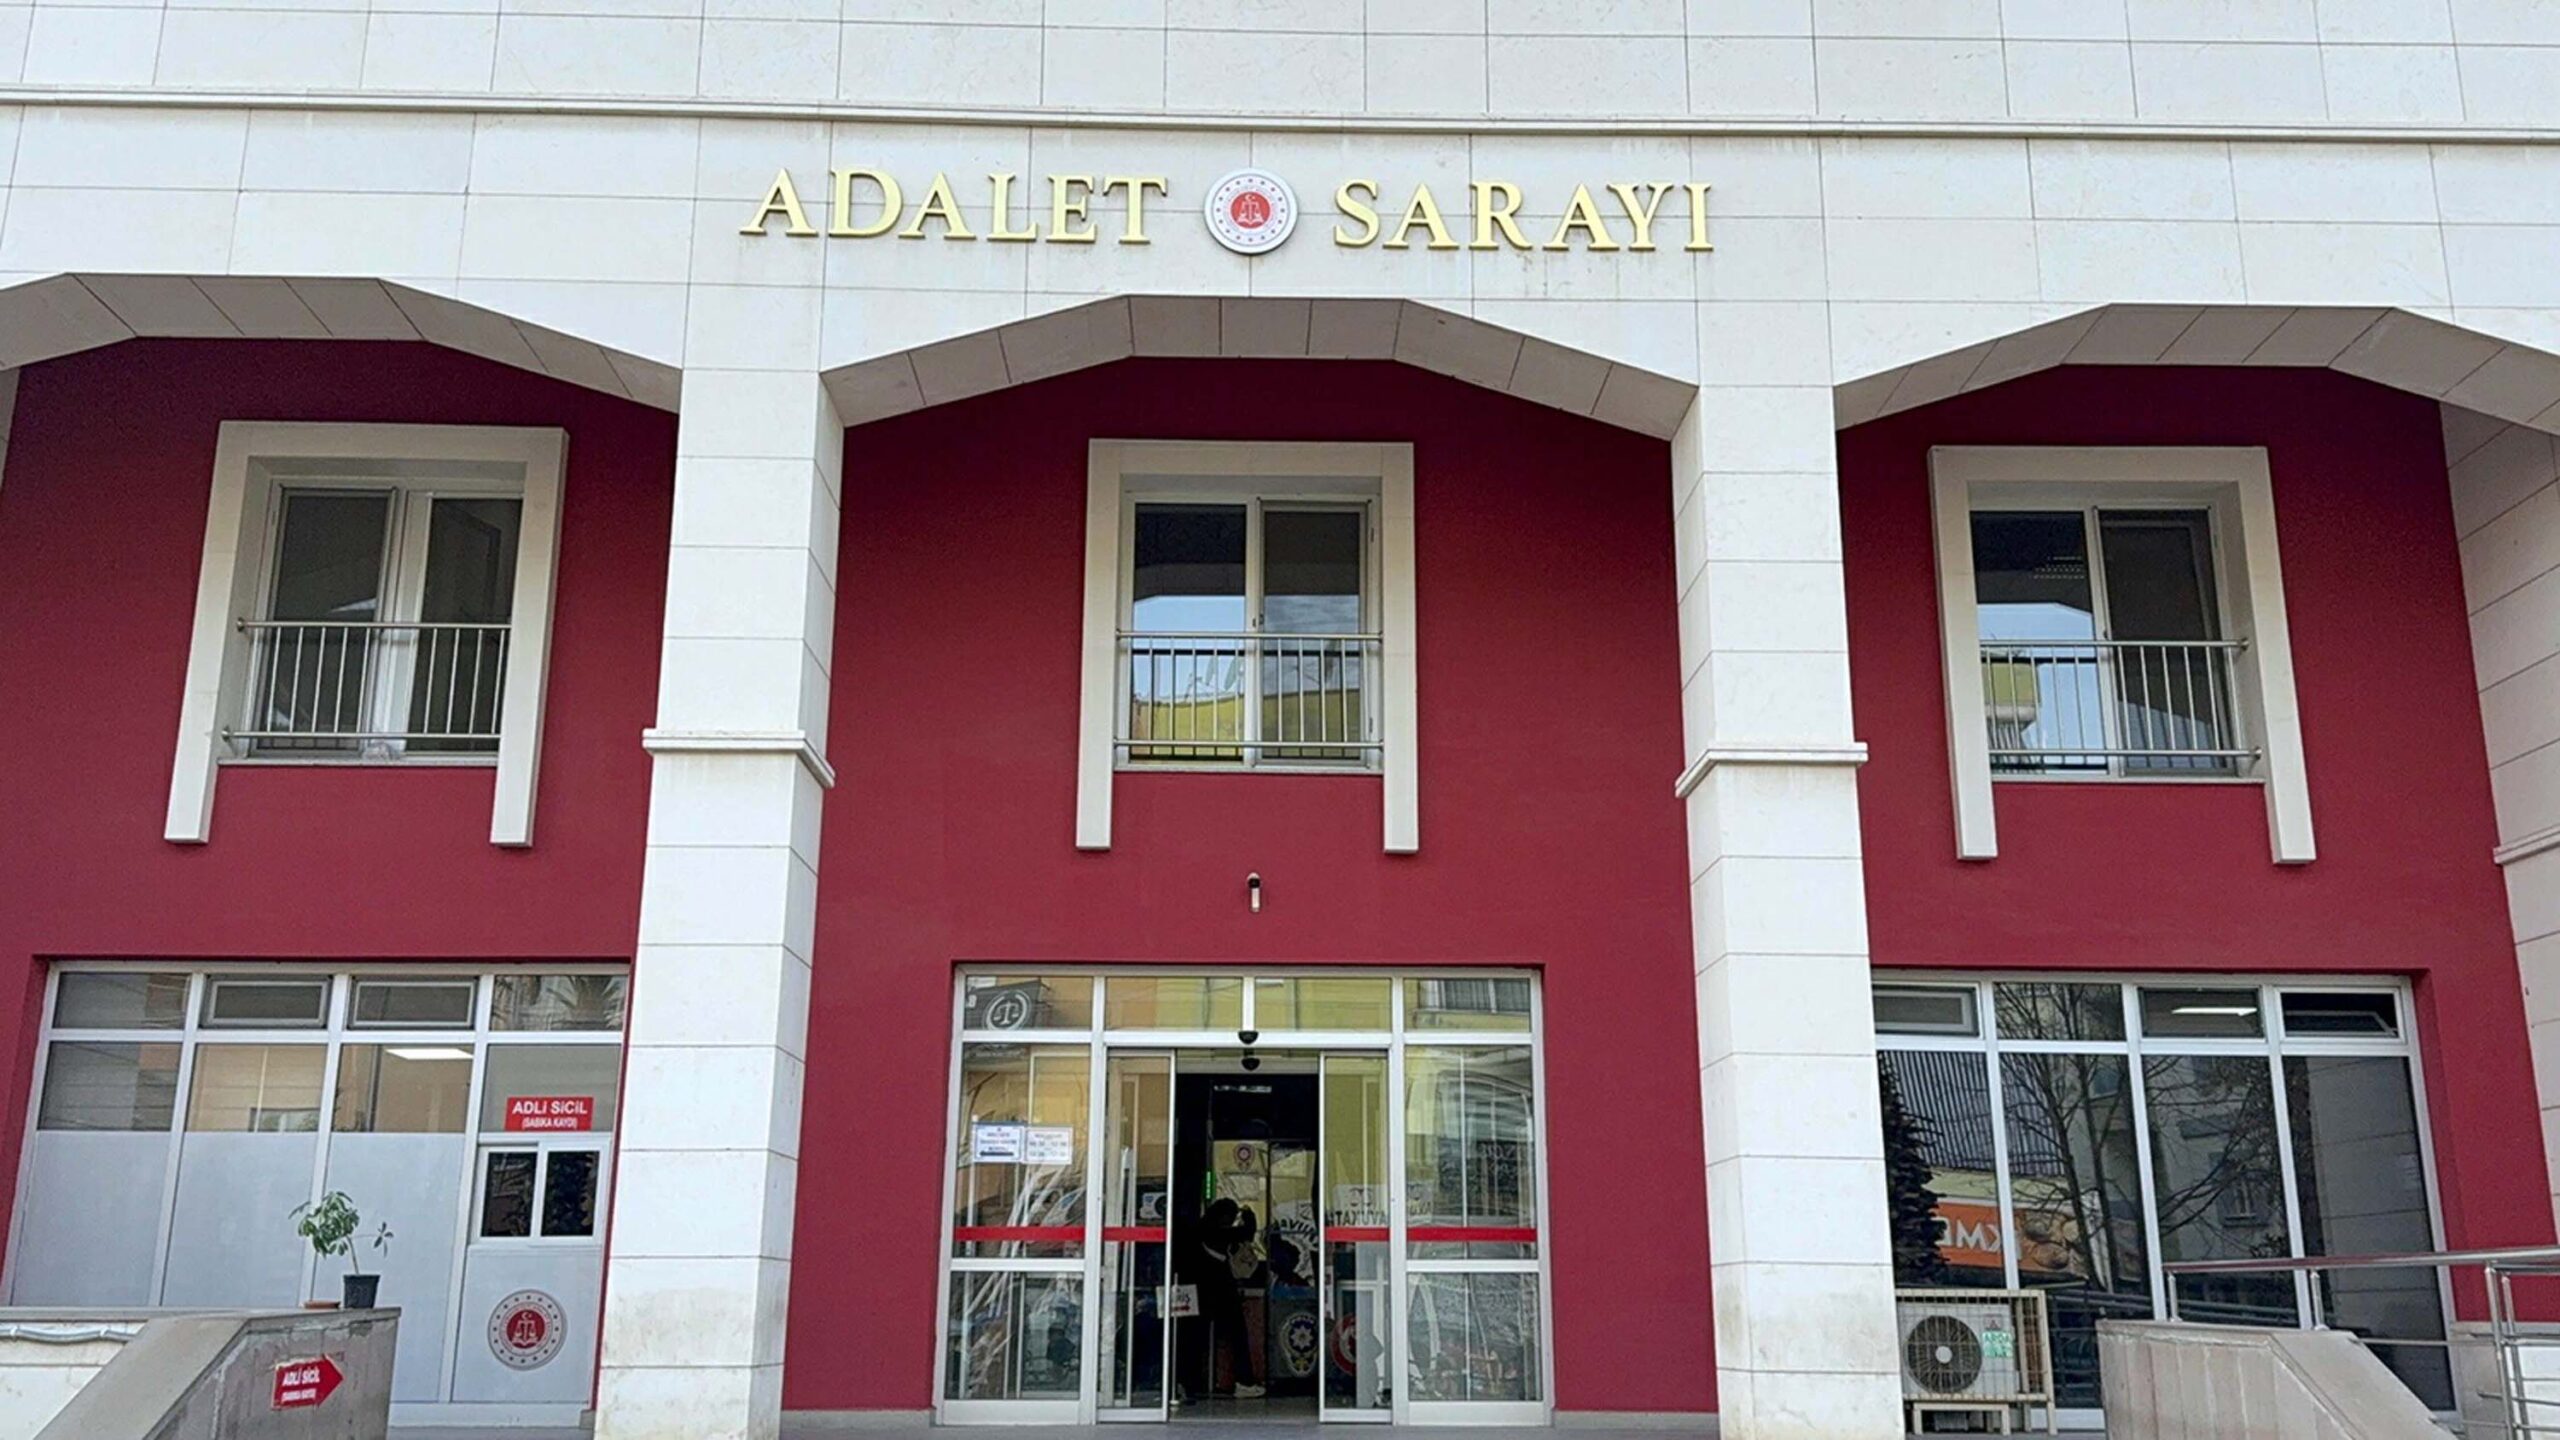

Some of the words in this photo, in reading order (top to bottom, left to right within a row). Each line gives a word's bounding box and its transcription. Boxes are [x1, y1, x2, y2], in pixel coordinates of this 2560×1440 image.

[739, 168, 1167, 244] ADALET
[1333, 179, 1714, 251] SARAYI
[511, 1100, 547, 1115] ADLİ
[550, 1100, 588, 1115] SİCİL
